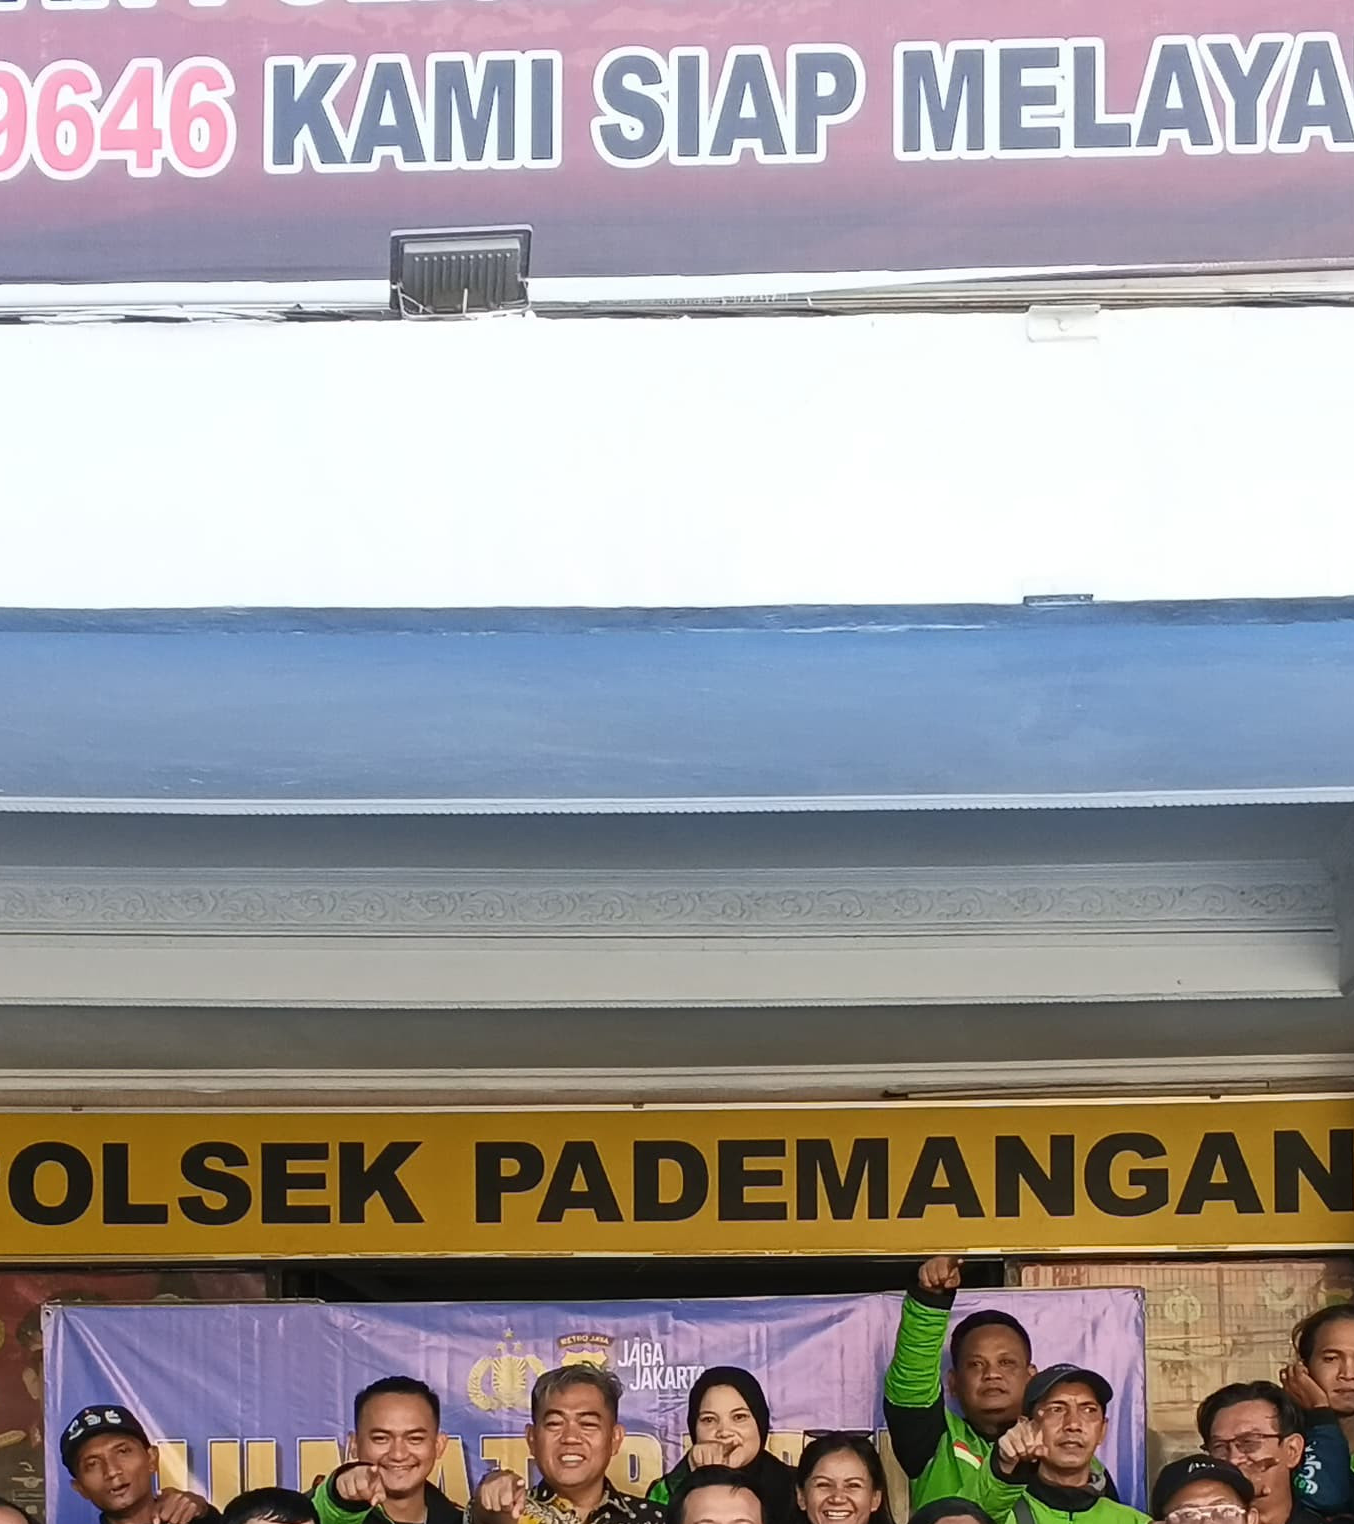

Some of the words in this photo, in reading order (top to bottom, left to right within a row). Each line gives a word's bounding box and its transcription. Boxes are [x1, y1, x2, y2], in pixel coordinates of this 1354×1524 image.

[269, 55, 557, 168] KAMI
[595, 48, 861, 164] SIAP
[474, 1128, 1354, 1224] PADEMANGAN
[618, 1337, 664, 1368] JAGA
